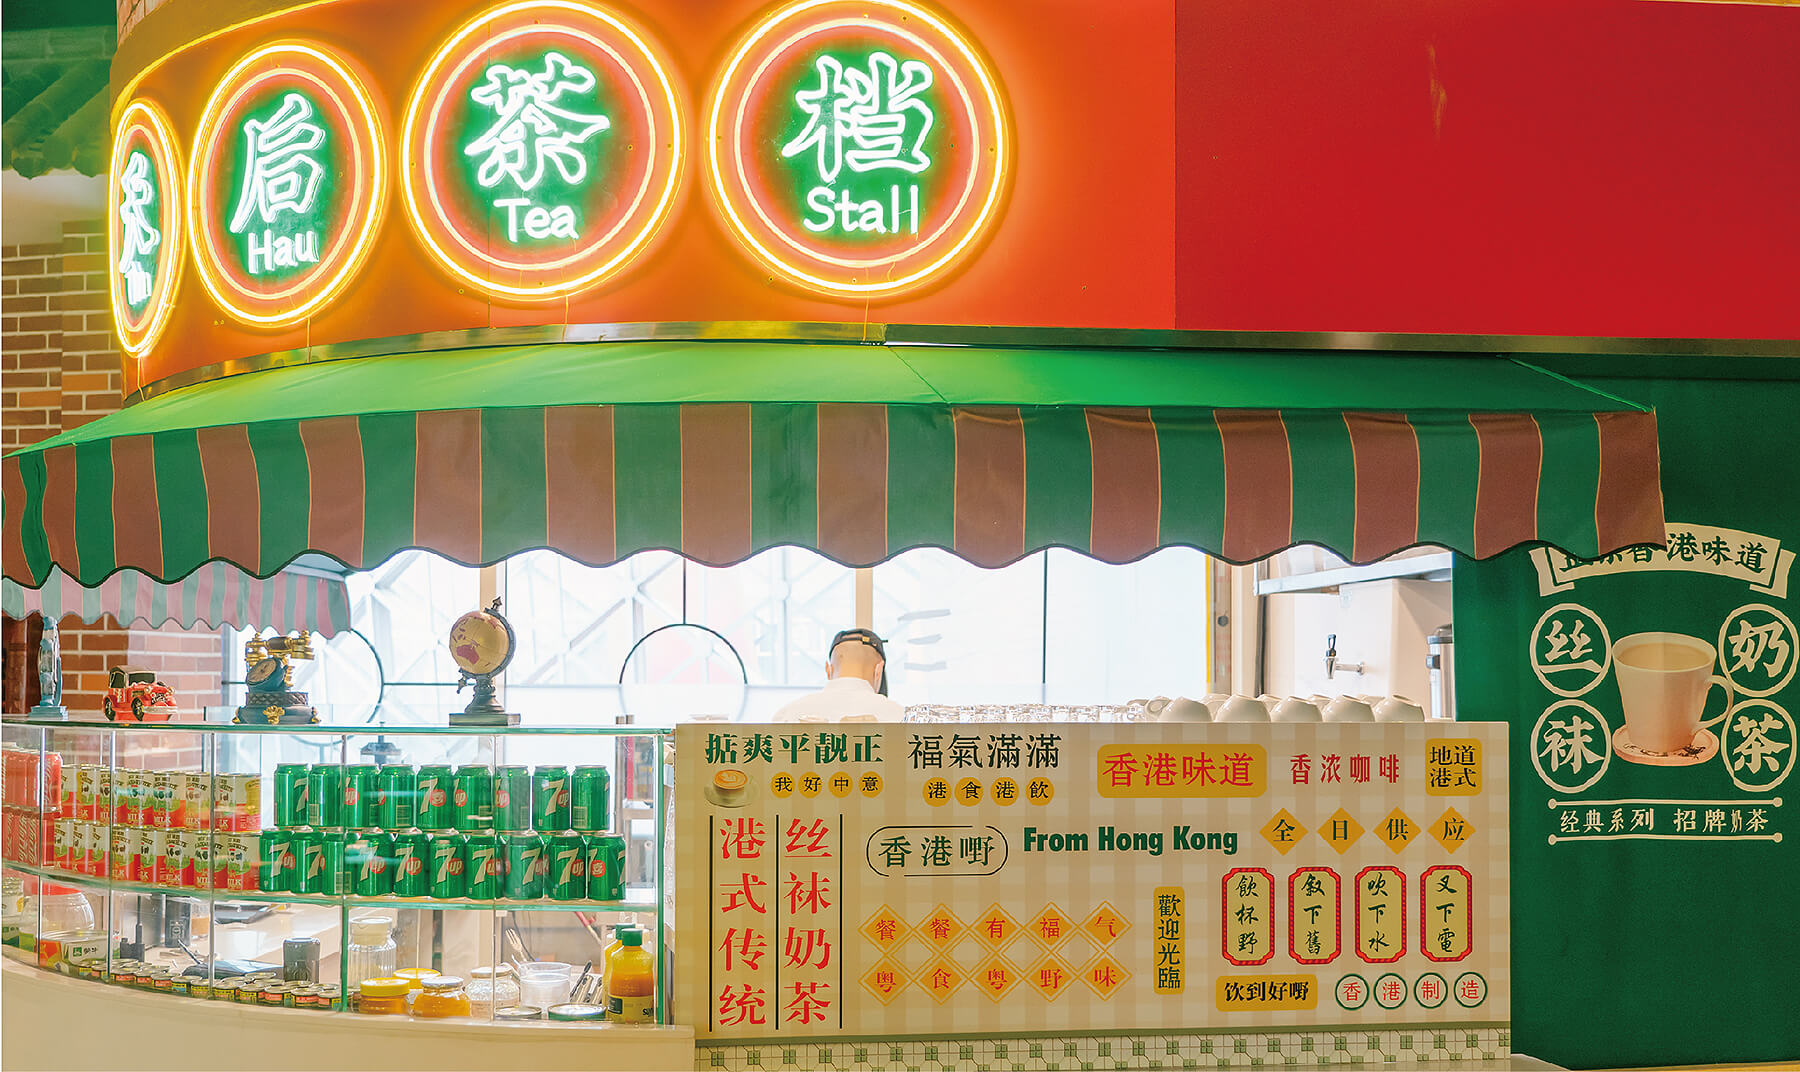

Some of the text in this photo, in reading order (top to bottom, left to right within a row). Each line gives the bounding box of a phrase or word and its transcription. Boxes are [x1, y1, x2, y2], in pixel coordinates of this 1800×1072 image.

[248, 229, 319, 274] Hau
[494, 198, 579, 242] Tea
[803, 184, 919, 234] Stall
[705, 733, 884, 765] 掂爽平靓正
[908, 734, 1062, 769] 福氣滿滿
[1429, 744, 1477, 767] 地道
[775, 776, 879, 793] 我好中意
[1102, 752, 1254, 788] 香港味道
[1290, 753, 1400, 785] 香浓咖啡
[1429, 767, 1477, 788] 港式
[928, 782, 1050, 799] 港食港飲
[1272, 817, 1465, 843] 全日供应
[1560, 808, 1769, 833] 经典系列 招牌奶茶
[878, 836, 996, 868] 香港嘢
[1023, 826, 1239, 856] From Hong Kong
[435, 847, 464, 884] 7up
[718, 817, 768, 1027] 港式传统
[784, 817, 833, 1025] 丝袜奶茶
[876, 916, 1117, 941] 餐餐有福气
[1368, 872, 1389, 953] 吹下水
[1158, 893, 1181, 990] 歡迎光臨
[1225, 981, 1309, 1002] 饮到好嘢
[1343, 979, 1479, 1002] 香港制造
